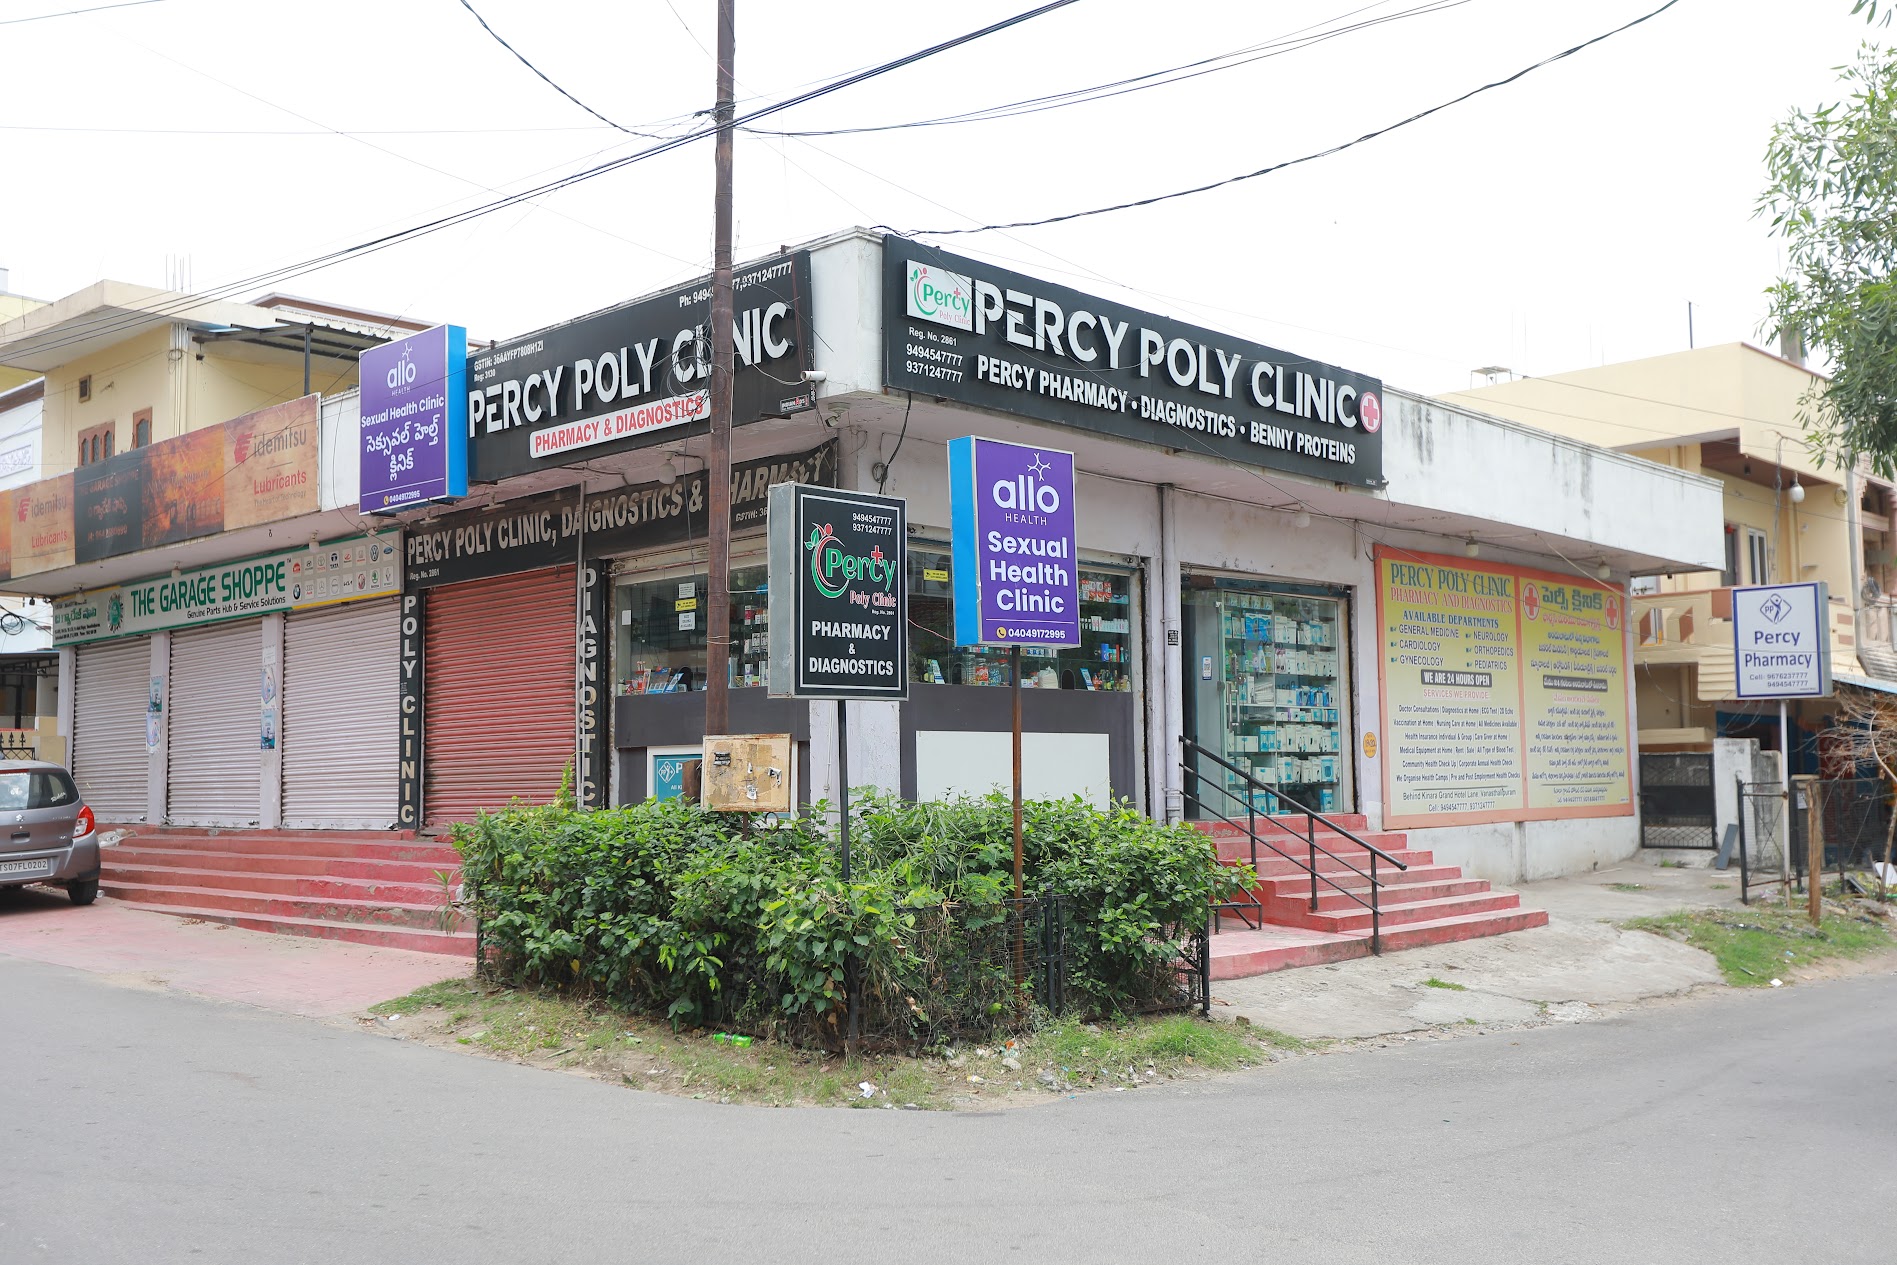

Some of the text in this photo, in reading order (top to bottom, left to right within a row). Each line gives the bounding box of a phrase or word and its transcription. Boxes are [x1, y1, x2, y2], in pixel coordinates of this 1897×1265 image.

[680, 295, 692, 308] Ph:
[923, 284, 970, 317] Percy
[940, 310, 970, 326] Poly Clinic
[909, 326, 957, 346] Reg. No. 2861
[906, 344, 963, 366] 9494547777
[976, 280, 1357, 428] PERCY POLY CLINIC
[387, 360, 416, 388] allo
[469, 302, 791, 438] PERCY POLY CLNIC
[474, 358, 492, 372] GSTIN:
[906, 360, 963, 383] 9371247777
[392, 386, 410, 396] HEALTH
[362, 394, 444, 428] Sexual Health Clinic
[978, 354, 1356, 465] PERCY PHARMACY DIAGNOSTICS BENNY PROTEINS
[535, 394, 704, 453] PHARMACY & DIAGNOSTICS
[254, 428, 306, 457] idemitsu
[254, 470, 306, 495] Lubricants
[993, 475, 1060, 514] allo
[32, 494, 66, 518] idemitsu
[407, 531, 452, 566] PERCY
[456, 521, 493, 554] POLY
[498, 510, 557, 550] CLINIC,
[688, 479, 703, 513] &
[736, 511, 758, 522] GSTIN:
[852, 513, 892, 525] 9494547777
[1006, 513, 1047, 526] HEALTH
[32, 530, 68, 548] Lubricants
[852, 524, 892, 536] 9371247777
[988, 530, 1068, 558] Sexual
[410, 572, 420, 580] Reg.
[420, 570, 428, 579] No.
[826, 548, 896, 592] Percy
[990, 560, 1068, 586] Health
[131, 562, 285, 618] THE GARAGE SHOPPE
[1391, 563, 1511, 598] PERCY POLY CLINIC
[187, 609, 206, 618] Genuine
[206, 607, 220, 616] Parts
[222, 605, 232, 613] Hub
[240, 600, 260, 610] Service
[260, 596, 286, 606] Solutions
[850, 590, 896, 609] Poly Clinic
[996, 589, 1064, 613] Clinic
[1391, 586, 1512, 614] PHARMACY AND DIAGNOSTICS
[1403, 610, 1499, 628] AVAILABLE DEPARTMENTS
[402, 595, 417, 679] POLY
[812, 620, 890, 640] PHARMACY
[1008, 628, 1066, 639] 04049172995
[1399, 624, 1459, 638] GENERAL MEDICINE
[1473, 631, 1508, 642] NEUROLOGY
[1754, 630, 1800, 646] Percy
[848, 643, 856, 654] &
[1399, 640, 1440, 651] CARDIOLOGY
[1474, 646, 1514, 656] ORTHOPEDICS
[810, 657, 894, 676] DIAGNOSTICS
[1400, 655, 1444, 666] GYNECOLOGY
[1474, 660, 1508, 670] PEDIATRICS
[1745, 652, 1812, 668] Pharmacy
[1424, 672, 1490, 686] WE ARE 24 HOURS OPEN
[1768, 680, 1808, 688] 9494547777
[579, 568, 598, 812] DIAGNOSTIC
[1424, 689, 1452, 698] SERVICES
[1454, 690, 1464, 698] WE
[401, 695, 416, 823] CLINIC
[1403, 792, 1420, 800] Behind
[1422, 792, 1438, 800] Kinara
[1439, 791, 1454, 799] Grand
[1454, 790, 1466, 798] Hotel
